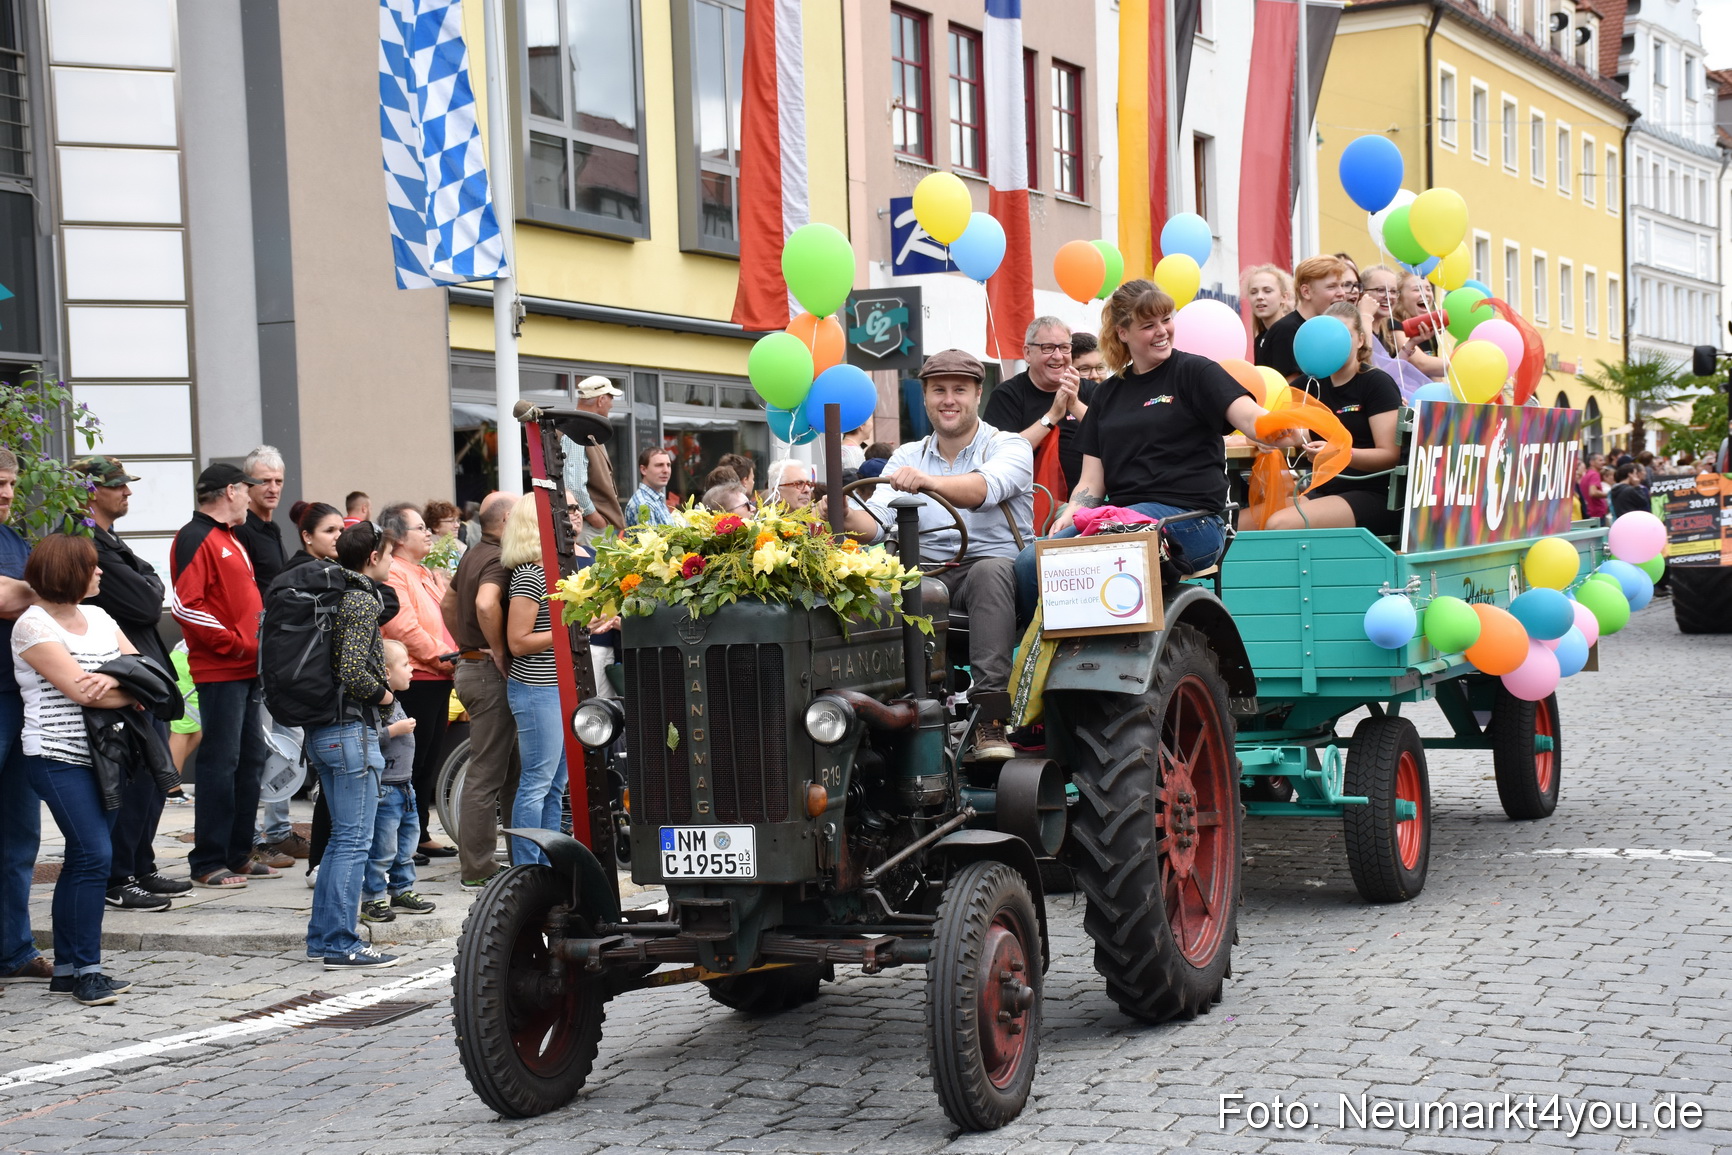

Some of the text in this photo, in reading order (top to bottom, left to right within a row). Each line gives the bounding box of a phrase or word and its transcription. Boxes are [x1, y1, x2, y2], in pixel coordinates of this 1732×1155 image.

[866, 310, 891, 343] G2
[1412, 441, 1578, 508] DIE WELT IST BUNT
[1689, 498, 1718, 509] 30.09.
[1044, 566, 1100, 579] EVANGELISCHE
[1044, 577, 1095, 593] JUGEND
[1045, 597, 1079, 607] Neumarkt
[829, 645, 904, 682] HANOMA
[687, 655, 711, 814] HANOMAG
[678, 830, 706, 851] NM
